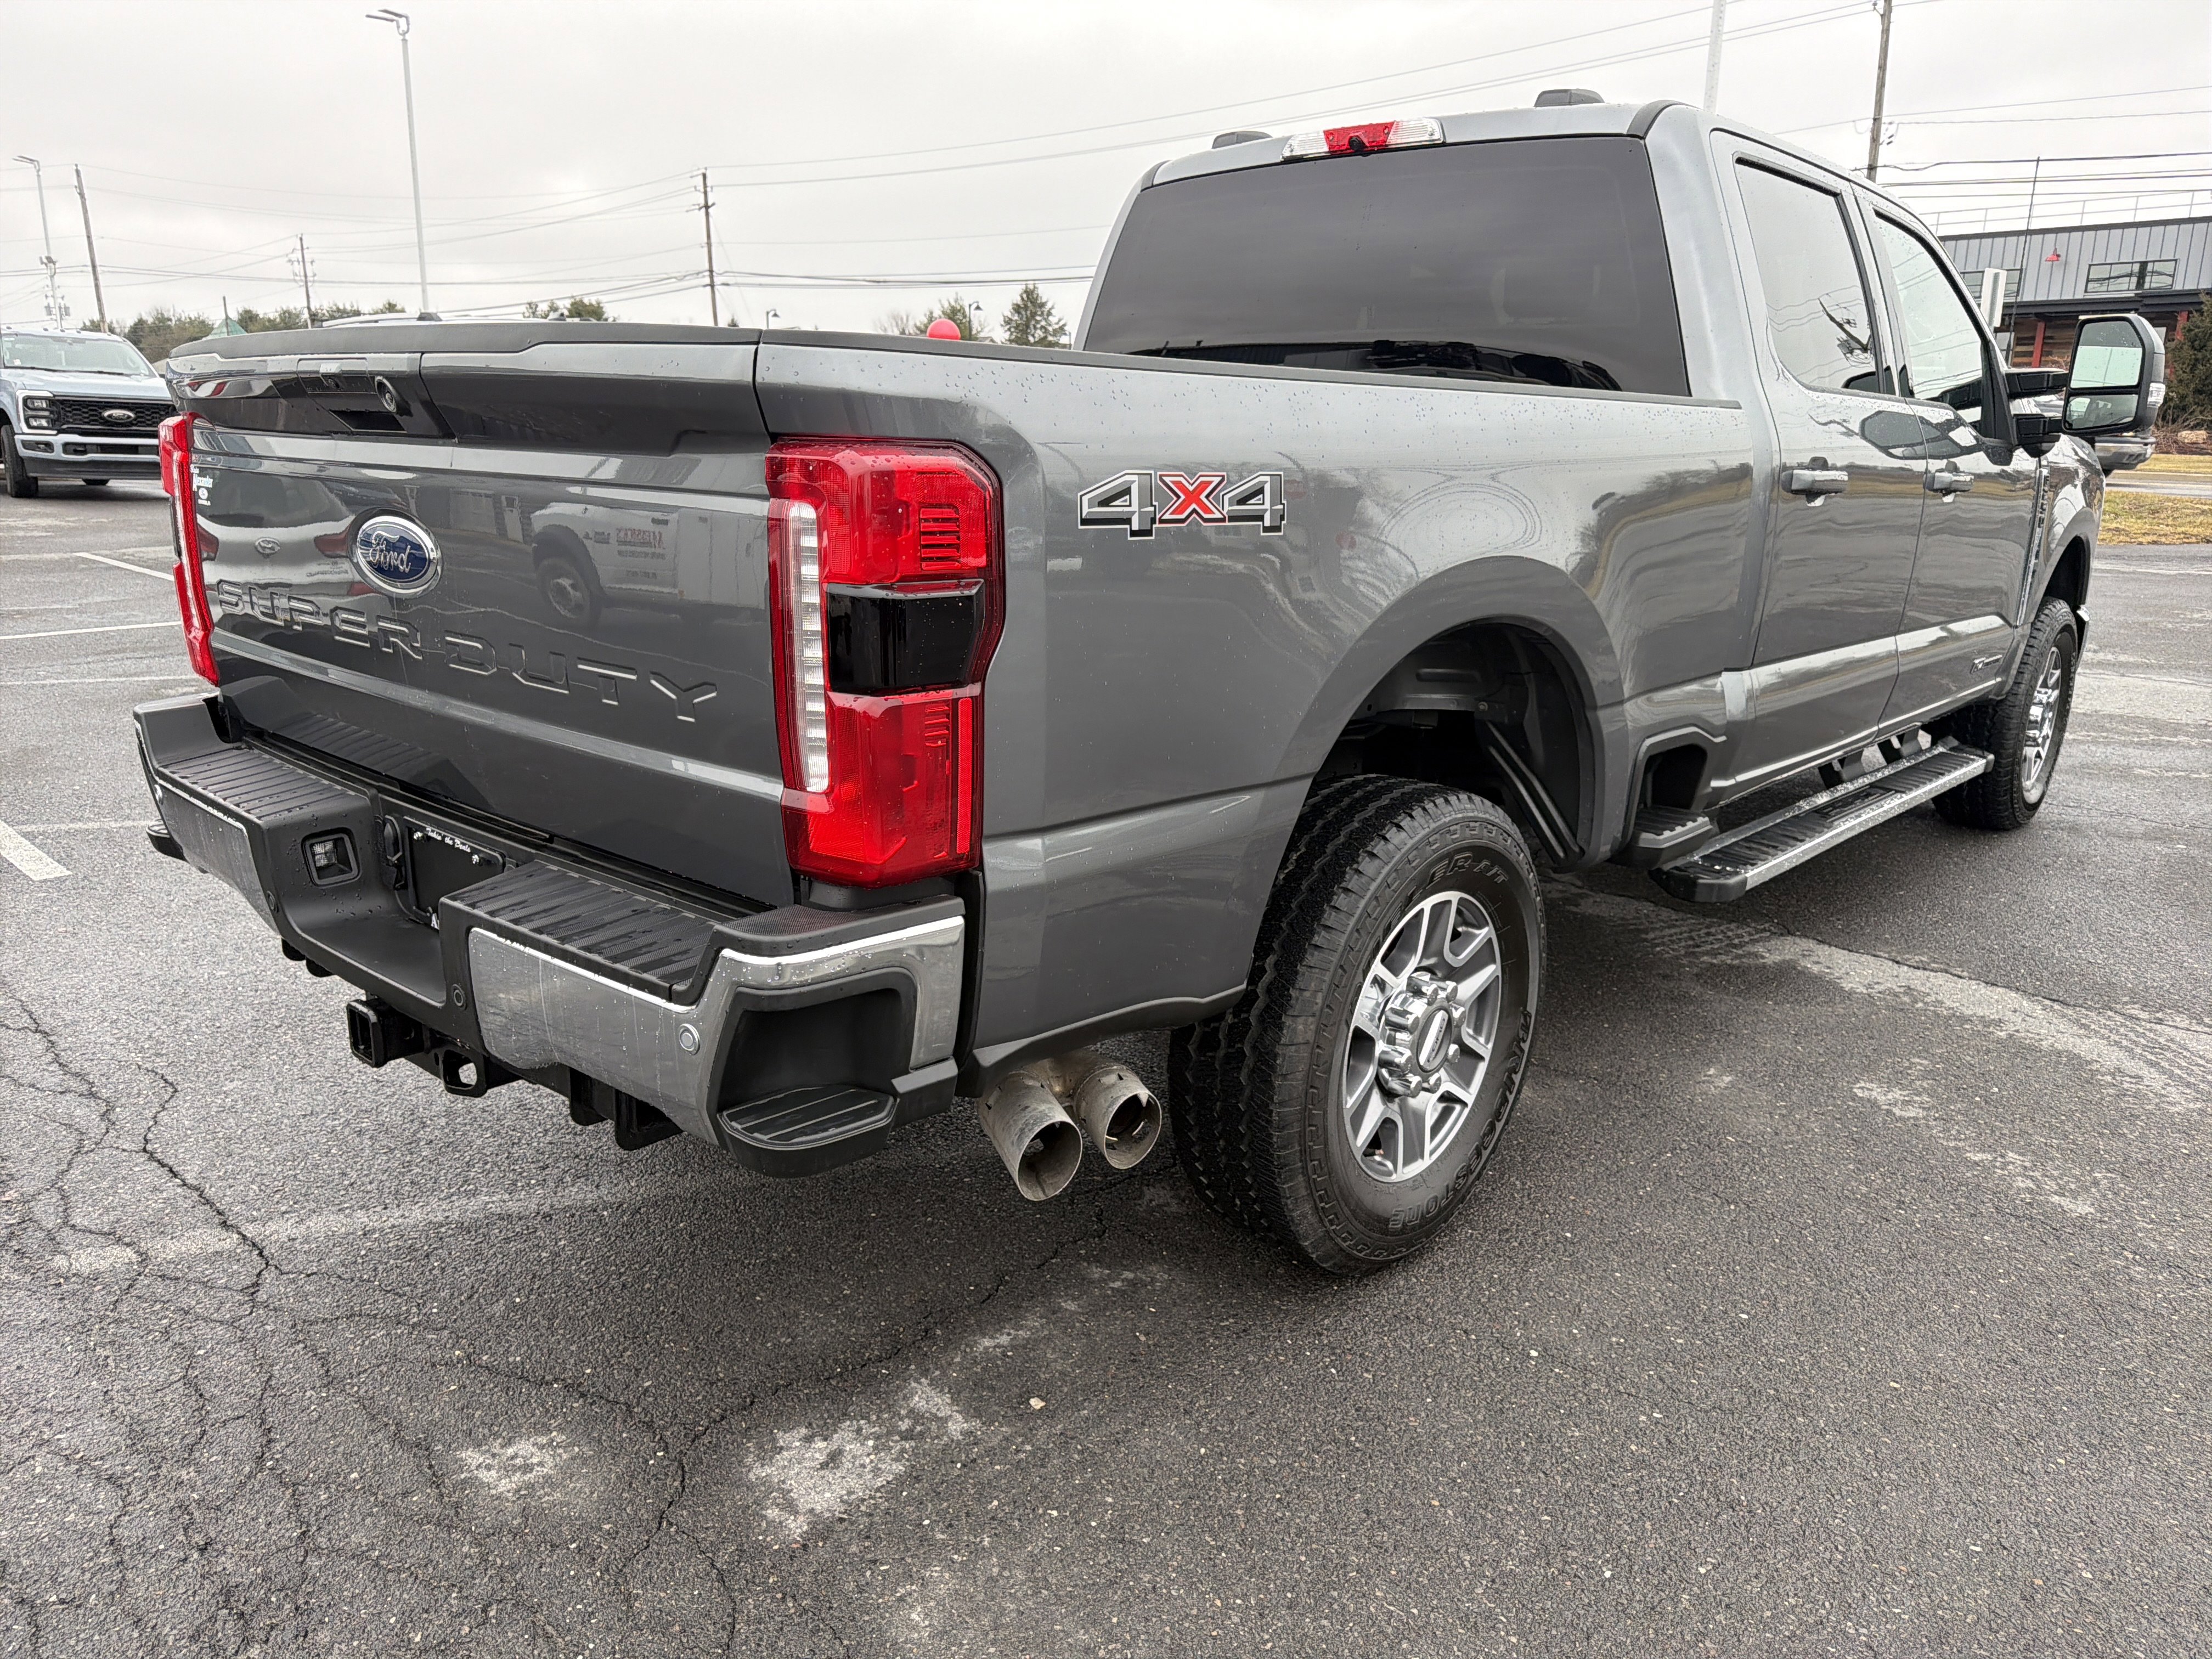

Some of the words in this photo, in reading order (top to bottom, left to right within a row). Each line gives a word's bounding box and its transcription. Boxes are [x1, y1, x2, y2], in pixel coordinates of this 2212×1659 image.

[369, 531, 411, 573] Ford
[216, 578, 422, 660] SUPER
[444, 629, 718, 723] DUTY
[444, 836, 453, 845] the
[454, 839, 471, 853] Deals
[1389, 1006, 1532, 1230] BRIDGESTONE
